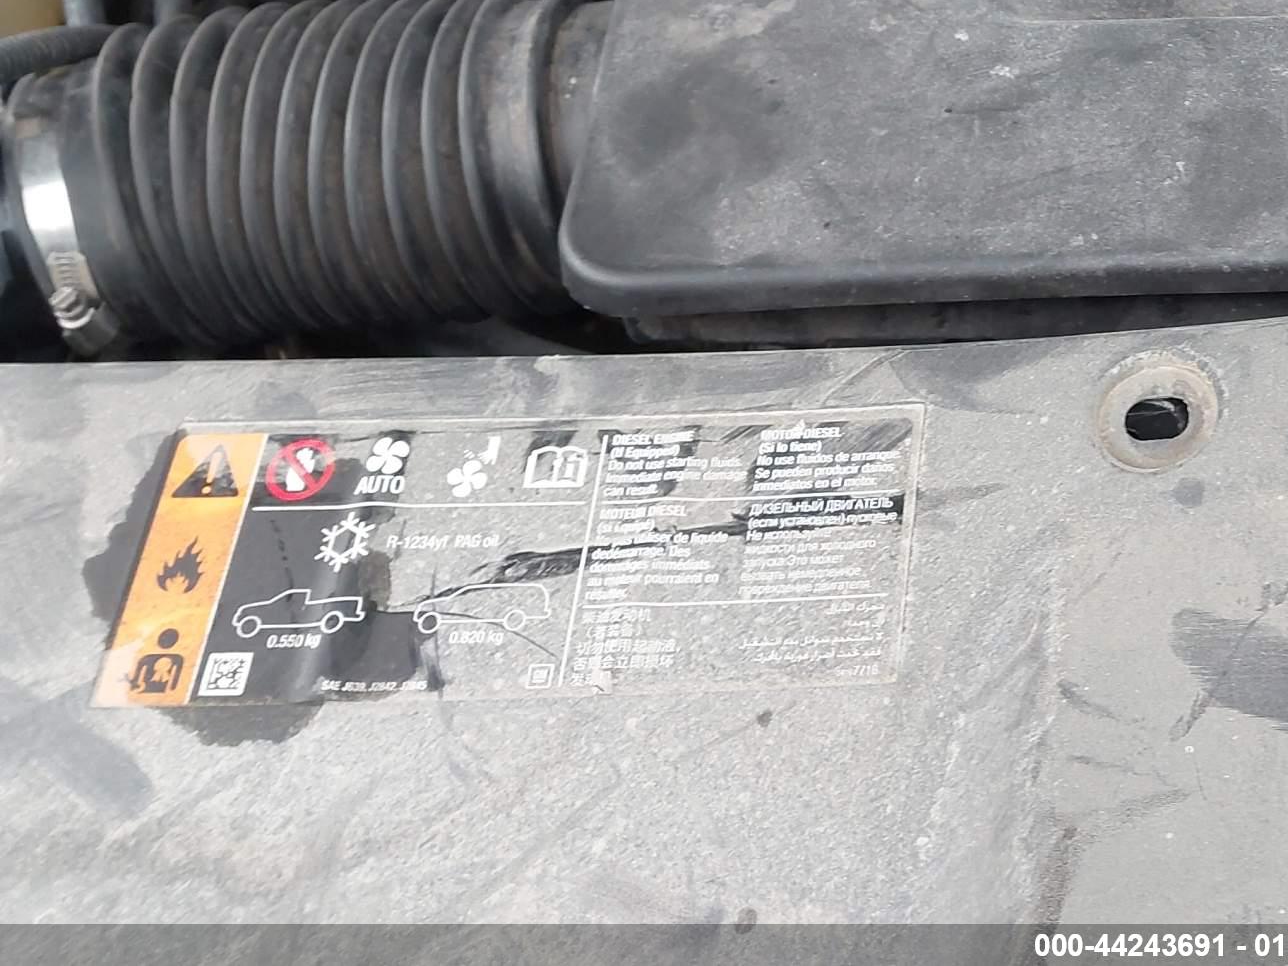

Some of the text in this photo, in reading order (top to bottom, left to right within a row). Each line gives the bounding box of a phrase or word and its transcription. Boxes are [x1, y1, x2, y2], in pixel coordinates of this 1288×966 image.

[612, 434, 652, 446] DIESEL
[608, 460, 624, 471] Do
[624, 459, 644, 470] not
[645, 460, 664, 470] use
[666, 457, 708, 469] starting
[756, 455, 772, 466] No
[774, 456, 795, 465] use
[796, 453, 834, 464] fluidos
[834, 452, 850, 462] de
[755, 468, 770, 479] Se
[771, 466, 812, 479] pueden
[814, 464, 860, 477] producir
[354, 476, 404, 495] AUTO
[814, 480, 829, 488] en
[830, 478, 842, 488] el
[604, 486, 624, 496] can
[647, 505, 687, 517] DIESEL
[750, 497, 894, 516] ДИЗЕЛЬНЫЙ ДВИГАТЕЛЬ
[386, 534, 500, 552] R-1234yf PAG oil
[673, 532, 689, 544] de
[690, 532, 728, 544] liquide
[669, 546, 691, 557] Des
[704, 573, 720, 583] en
[266, 634, 322, 648] 0.550 kg
[488, 630, 504, 646] kg
